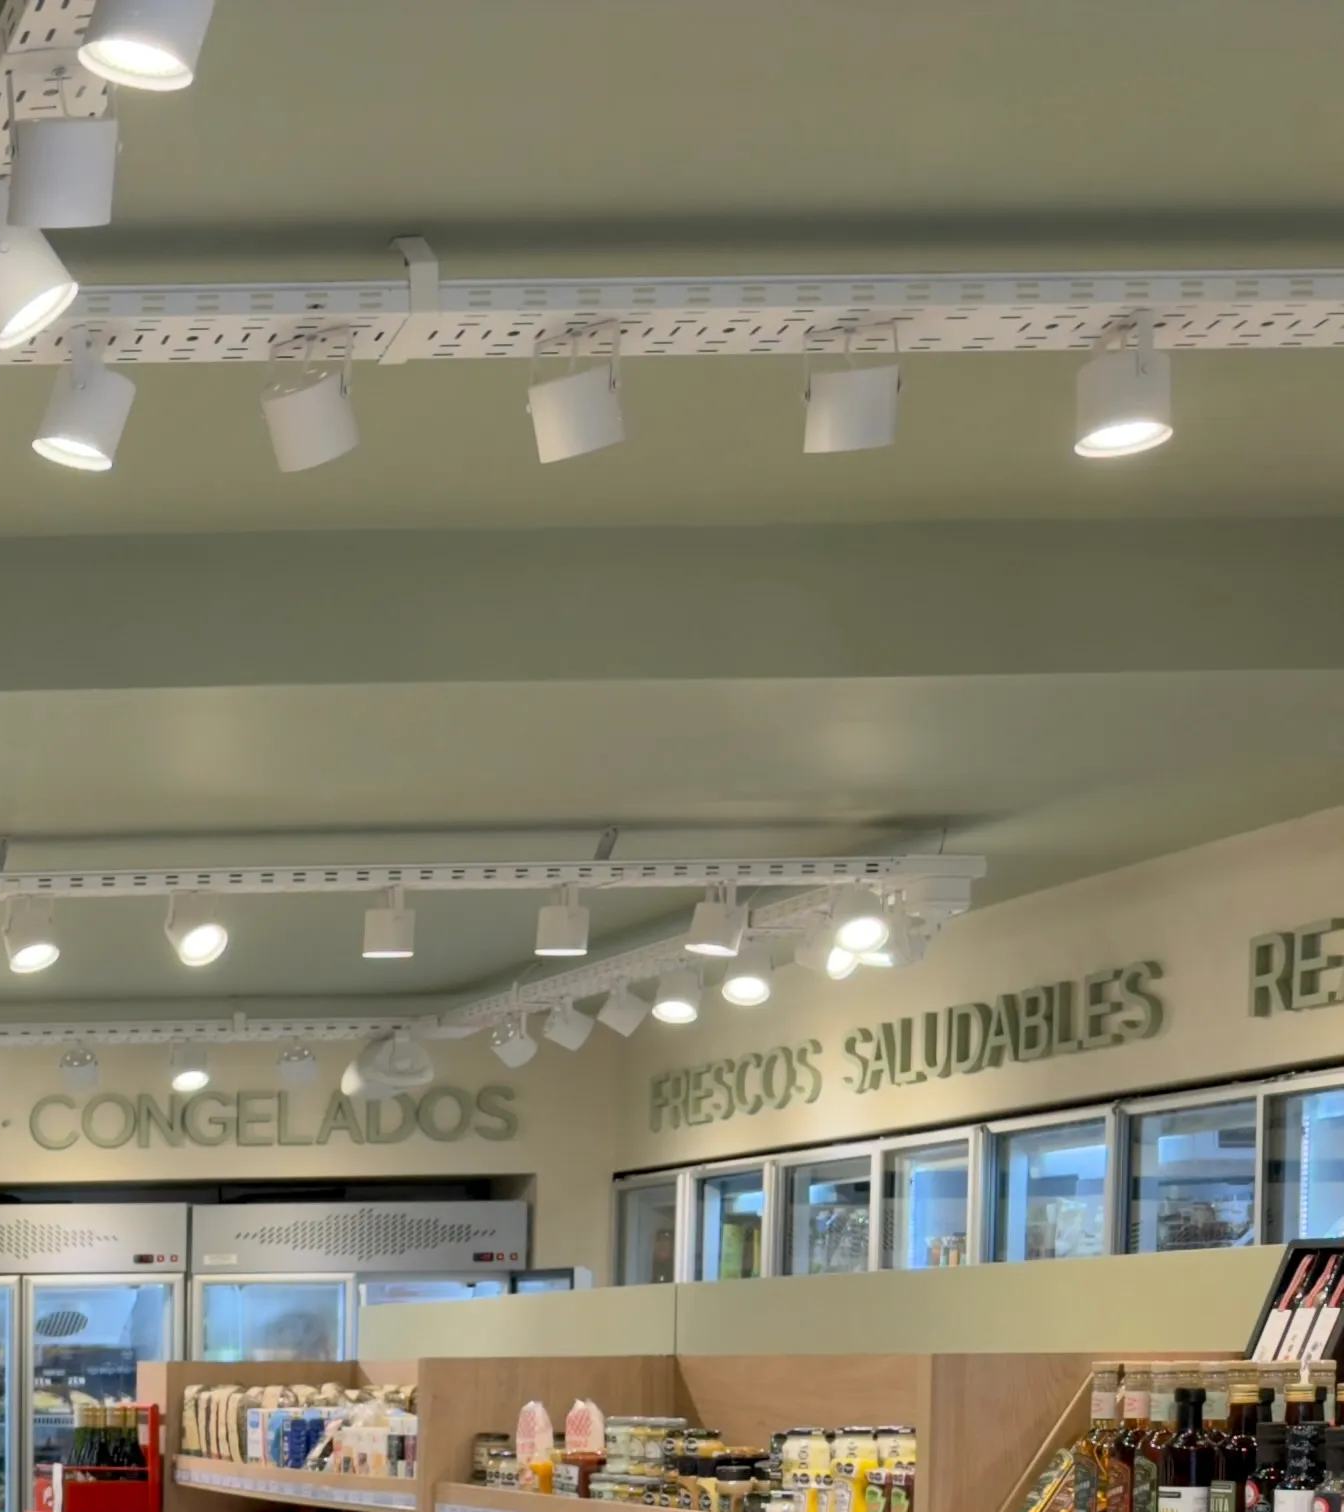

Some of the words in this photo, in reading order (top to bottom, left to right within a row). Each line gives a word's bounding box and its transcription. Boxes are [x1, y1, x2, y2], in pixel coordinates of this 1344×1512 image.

[649, 1038, 823, 1134] FRESCOS
[842, 960, 1164, 1095] SALUDABLES
[29, 1084, 519, 1149] CONGELADOS
